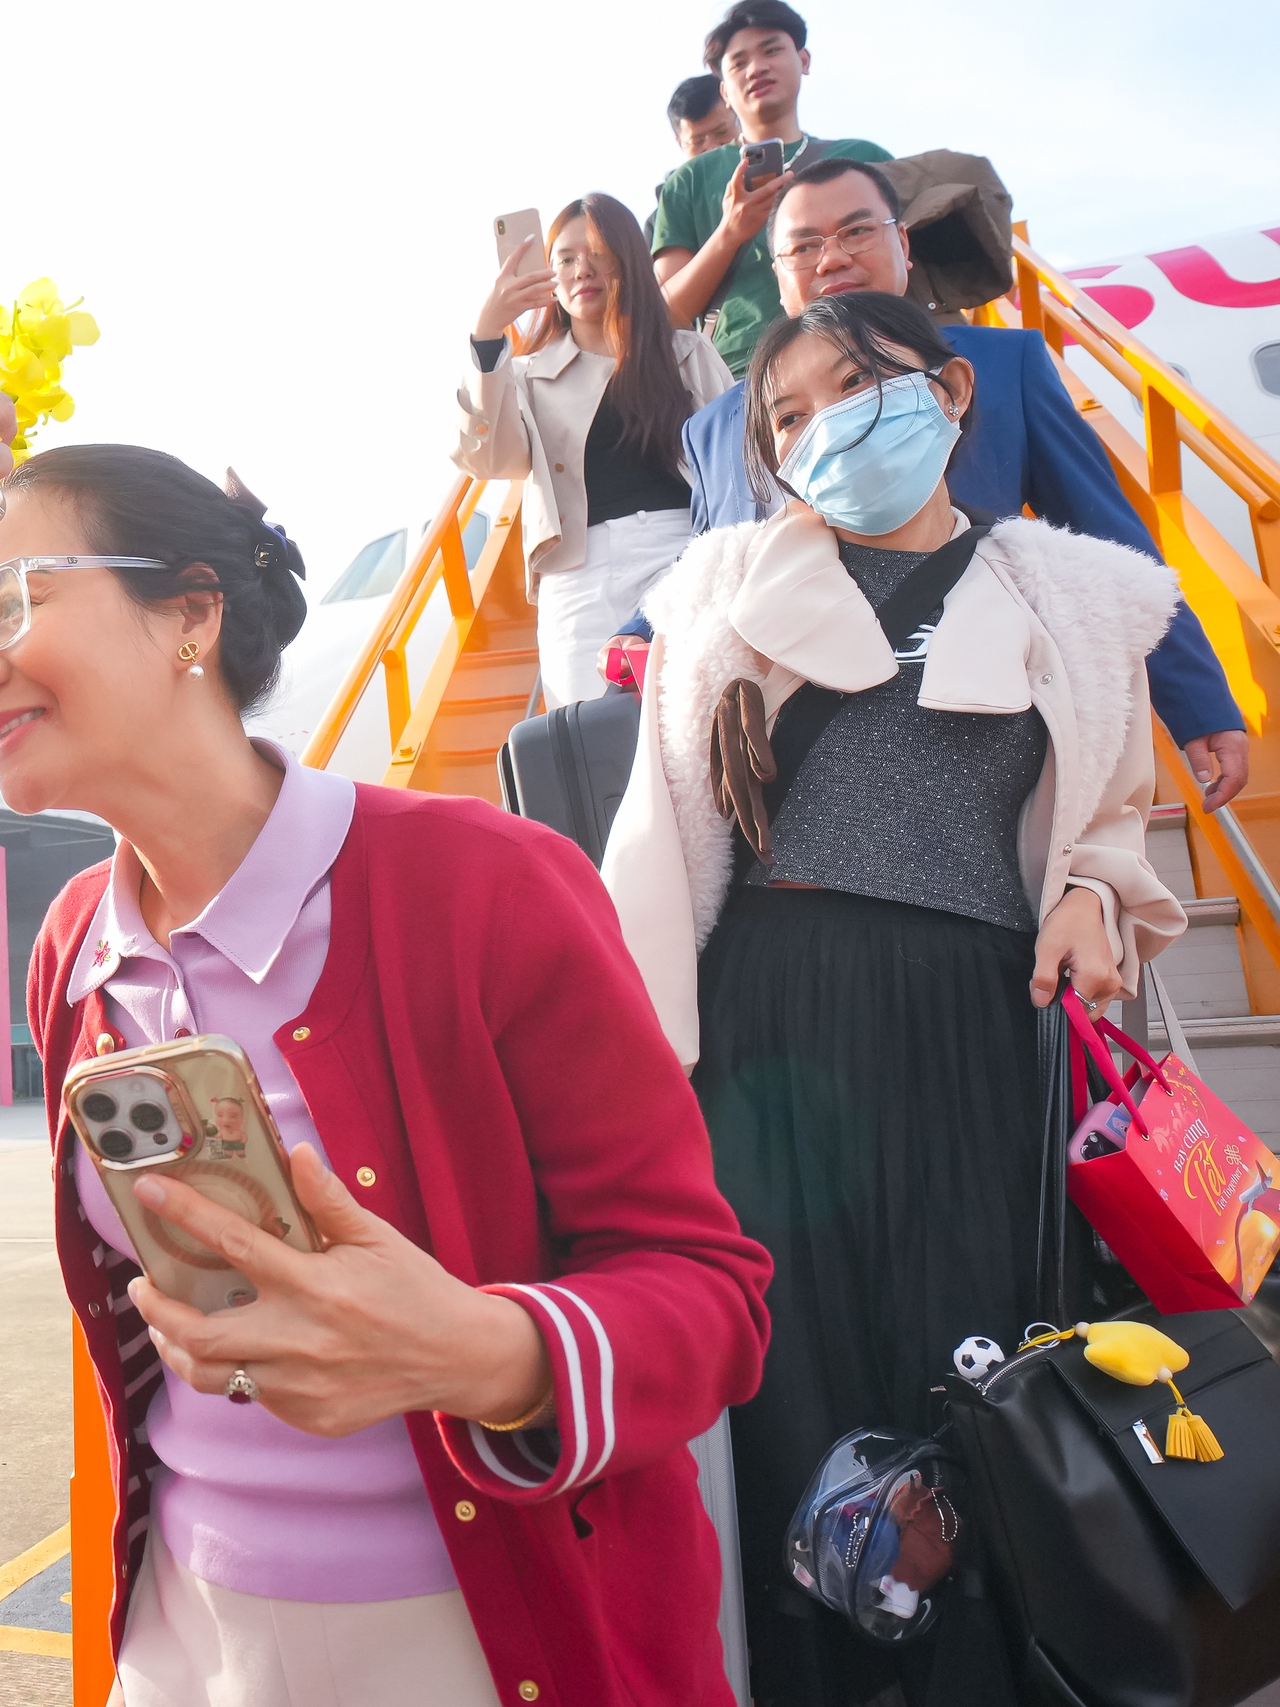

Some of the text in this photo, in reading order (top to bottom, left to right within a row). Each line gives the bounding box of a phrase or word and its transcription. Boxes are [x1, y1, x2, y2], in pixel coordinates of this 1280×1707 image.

[1173, 1118, 1210, 1174] Bay cùng
[1183, 1138, 1227, 1217] Tết
[1223, 1166, 1243, 1200] Together
